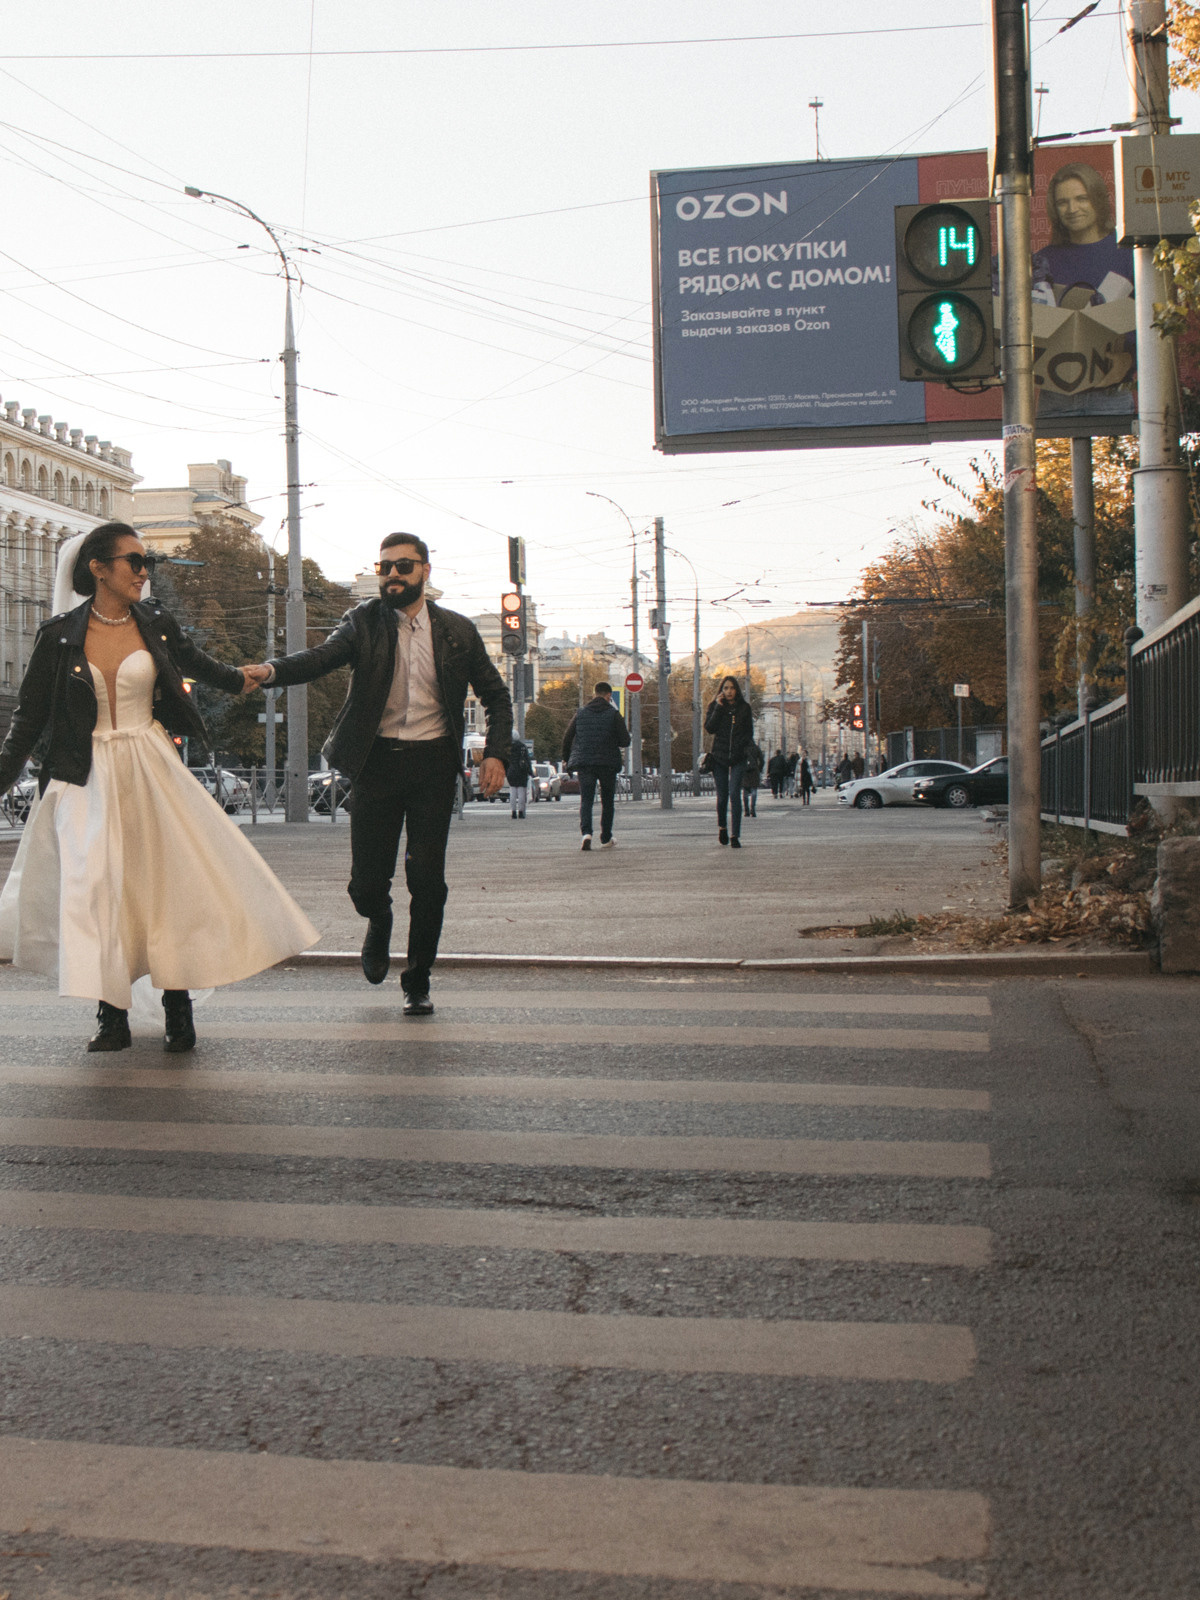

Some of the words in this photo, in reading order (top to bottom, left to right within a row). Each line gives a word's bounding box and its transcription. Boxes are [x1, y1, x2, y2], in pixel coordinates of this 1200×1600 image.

[676, 190, 788, 221] OZON
[678, 247, 721, 267] ВСЕ
[727, 240, 847, 264] ПОКУПКИ
[939, 226, 975, 267] 14
[678, 273, 761, 295] РЯДОМ
[766, 271, 783, 289] С
[789, 265, 892, 291] ДОМОМ!
[681, 307, 770, 322] Заказывайте
[774, 308, 783, 317] в
[786, 306, 826, 319] пункт
[681, 326, 732, 338] выдачи
[736, 322, 790, 334] заказов
[794, 319, 830, 331] Ozon
[505, 616, 520, 629] 46
